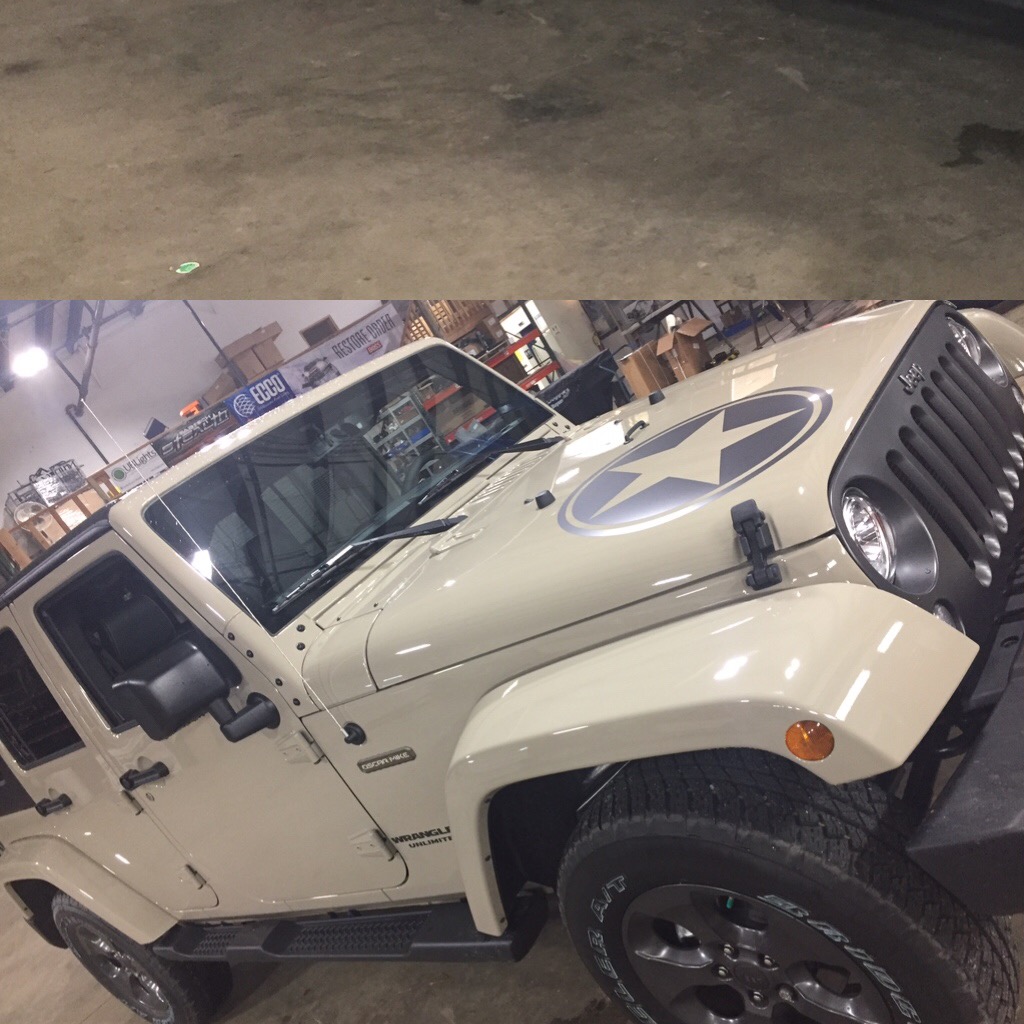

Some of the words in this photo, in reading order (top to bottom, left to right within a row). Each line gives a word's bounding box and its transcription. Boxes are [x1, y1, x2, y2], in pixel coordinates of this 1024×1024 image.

[331, 328, 371, 359] RESTORE
[365, 313, 396, 340] ORDER
[249, 374, 286, 405] ECCO
[361, 757, 389, 770] OSCAR
[389, 751, 410, 763] MIKE
